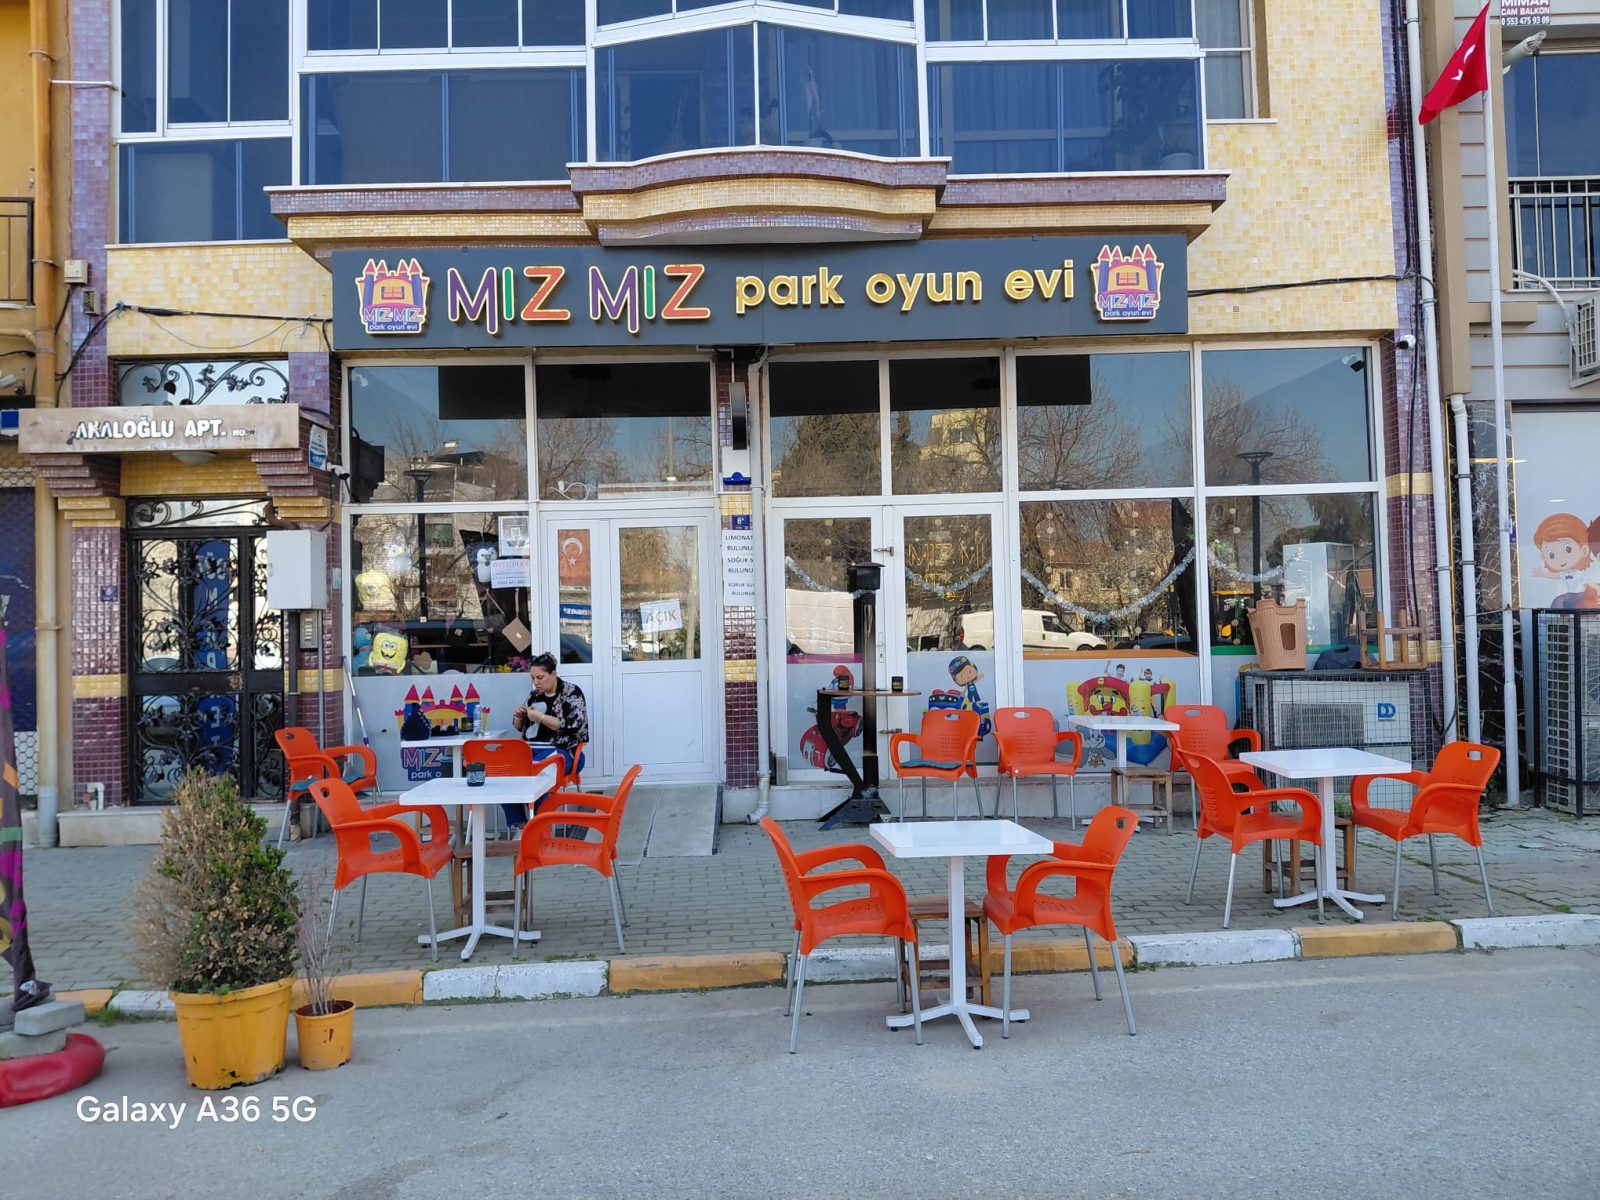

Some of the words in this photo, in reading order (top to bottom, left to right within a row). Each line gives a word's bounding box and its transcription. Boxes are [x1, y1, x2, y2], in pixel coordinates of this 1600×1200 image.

[1520, 7, 1550, 15] BALKON
[1507, 17, 1518, 25] 553
[1532, 16, 1540, 24] 93
[447, 265, 571, 335] MIZ
[588, 263, 711, 334] MIZ
[735, 267, 845, 315] park
[865, 270, 982, 312] oyun
[1004, 259, 1074, 300] evi
[1099, 293, 1127, 311] MIZ
[1128, 293, 1157, 311] MIZ
[363, 307, 392, 325] MIZ
[393, 307, 424, 325] MIZ
[76, 416, 174, 439] AKALOĞLU
[184, 419, 227, 438] APT.
[645, 609, 678, 626] AÇIK
[403, 747, 441, 771] MIZ
[411, 770, 432, 780] park
